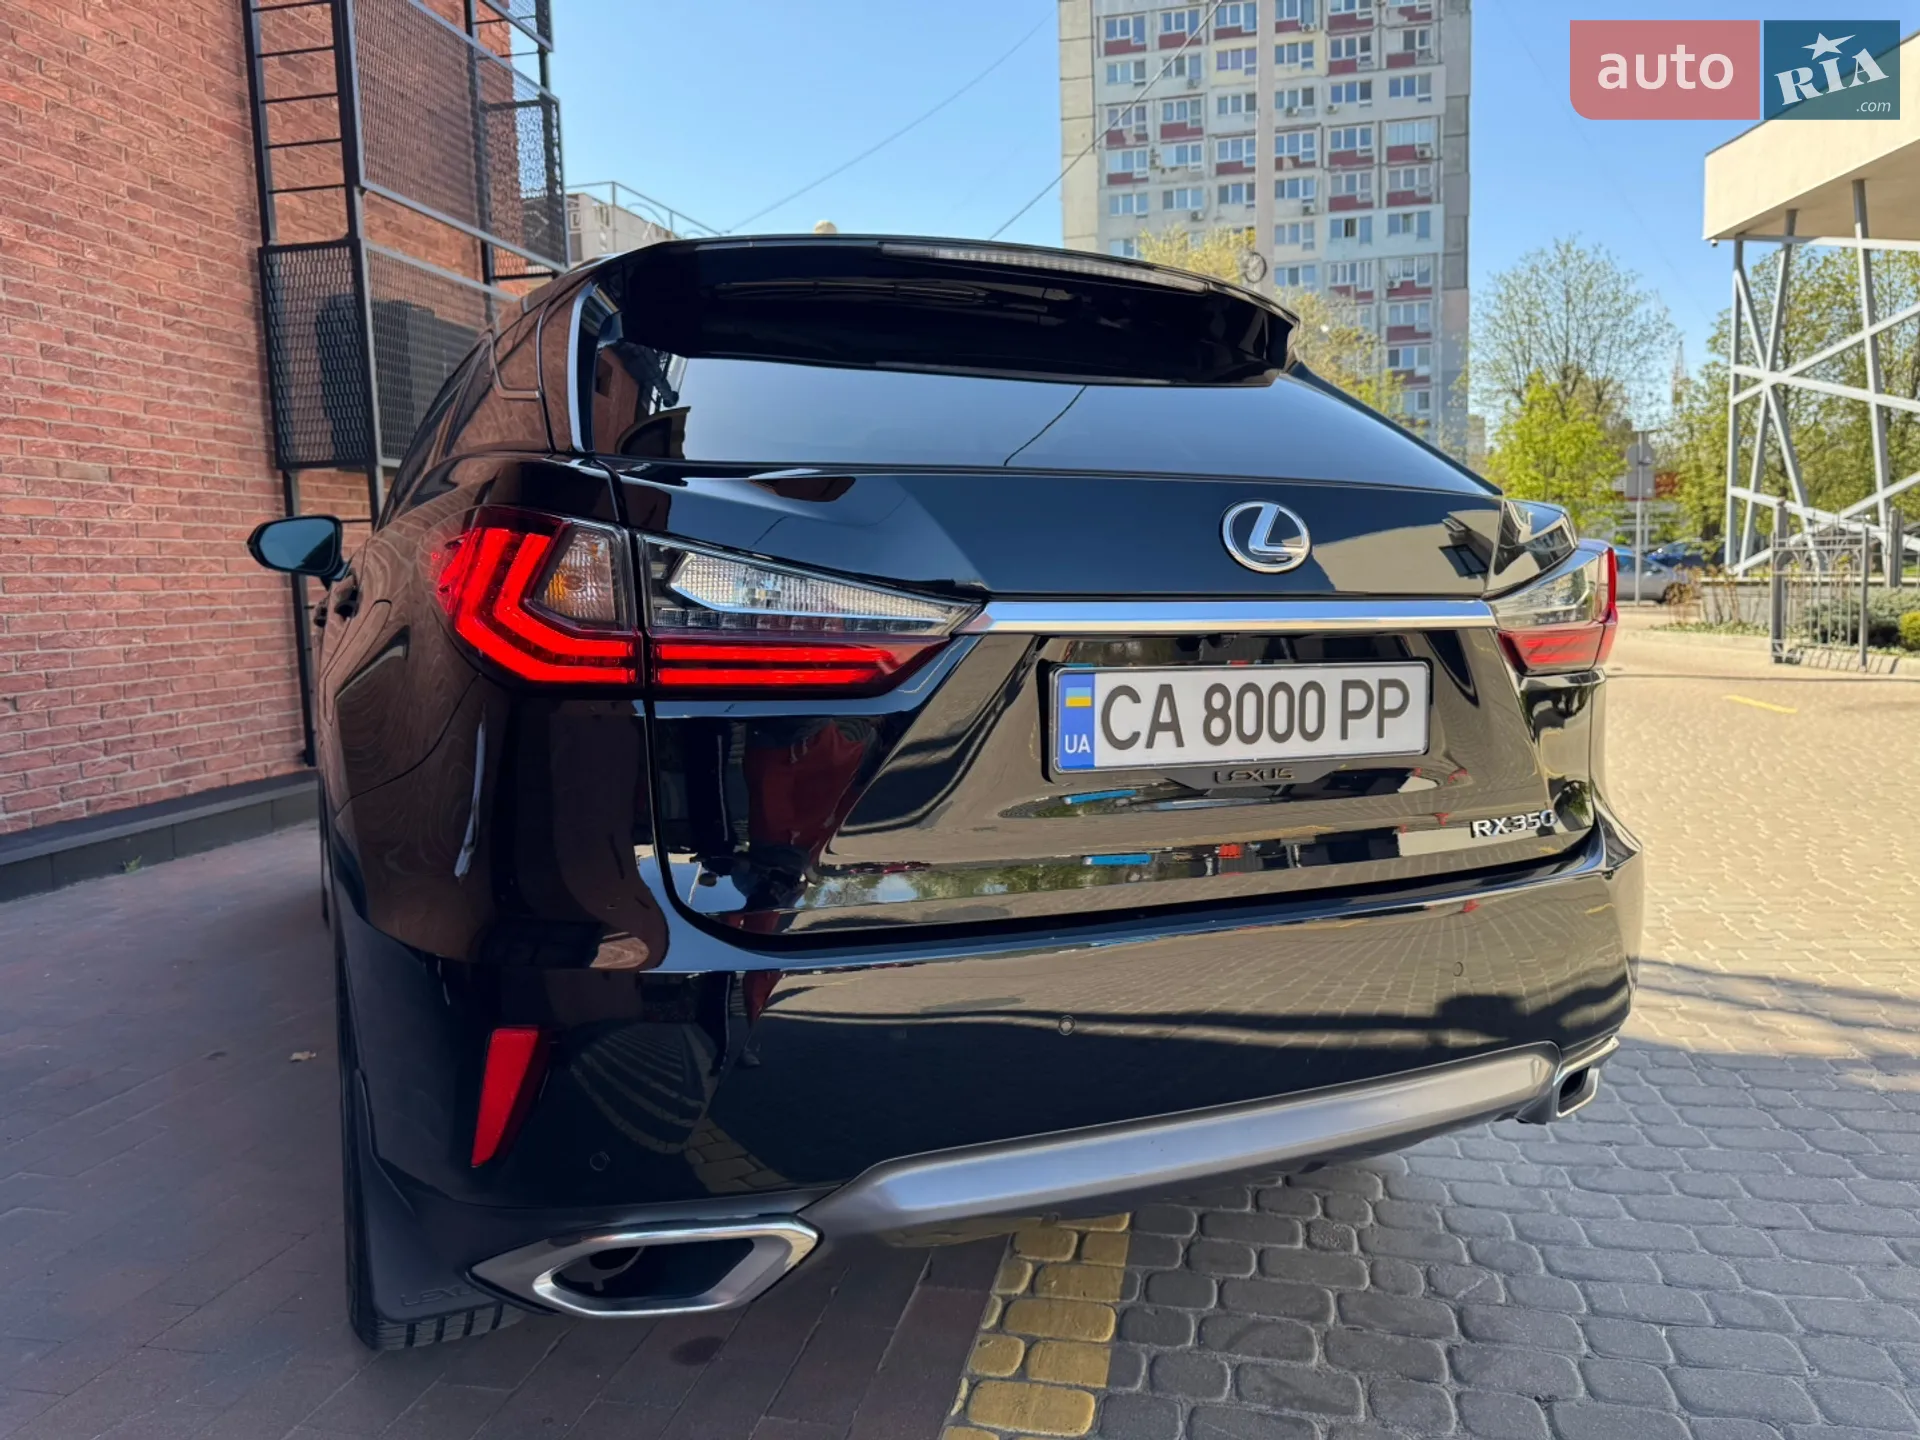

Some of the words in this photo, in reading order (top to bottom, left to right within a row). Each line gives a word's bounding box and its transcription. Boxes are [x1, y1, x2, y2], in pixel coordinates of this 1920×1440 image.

[1101, 683, 1185, 750] CA
[1203, 680, 1326, 746] 8000
[1340, 678, 1410, 740] PP
[1064, 734, 1091, 754] UA
[1213, 767, 1295, 784] LEXUS
